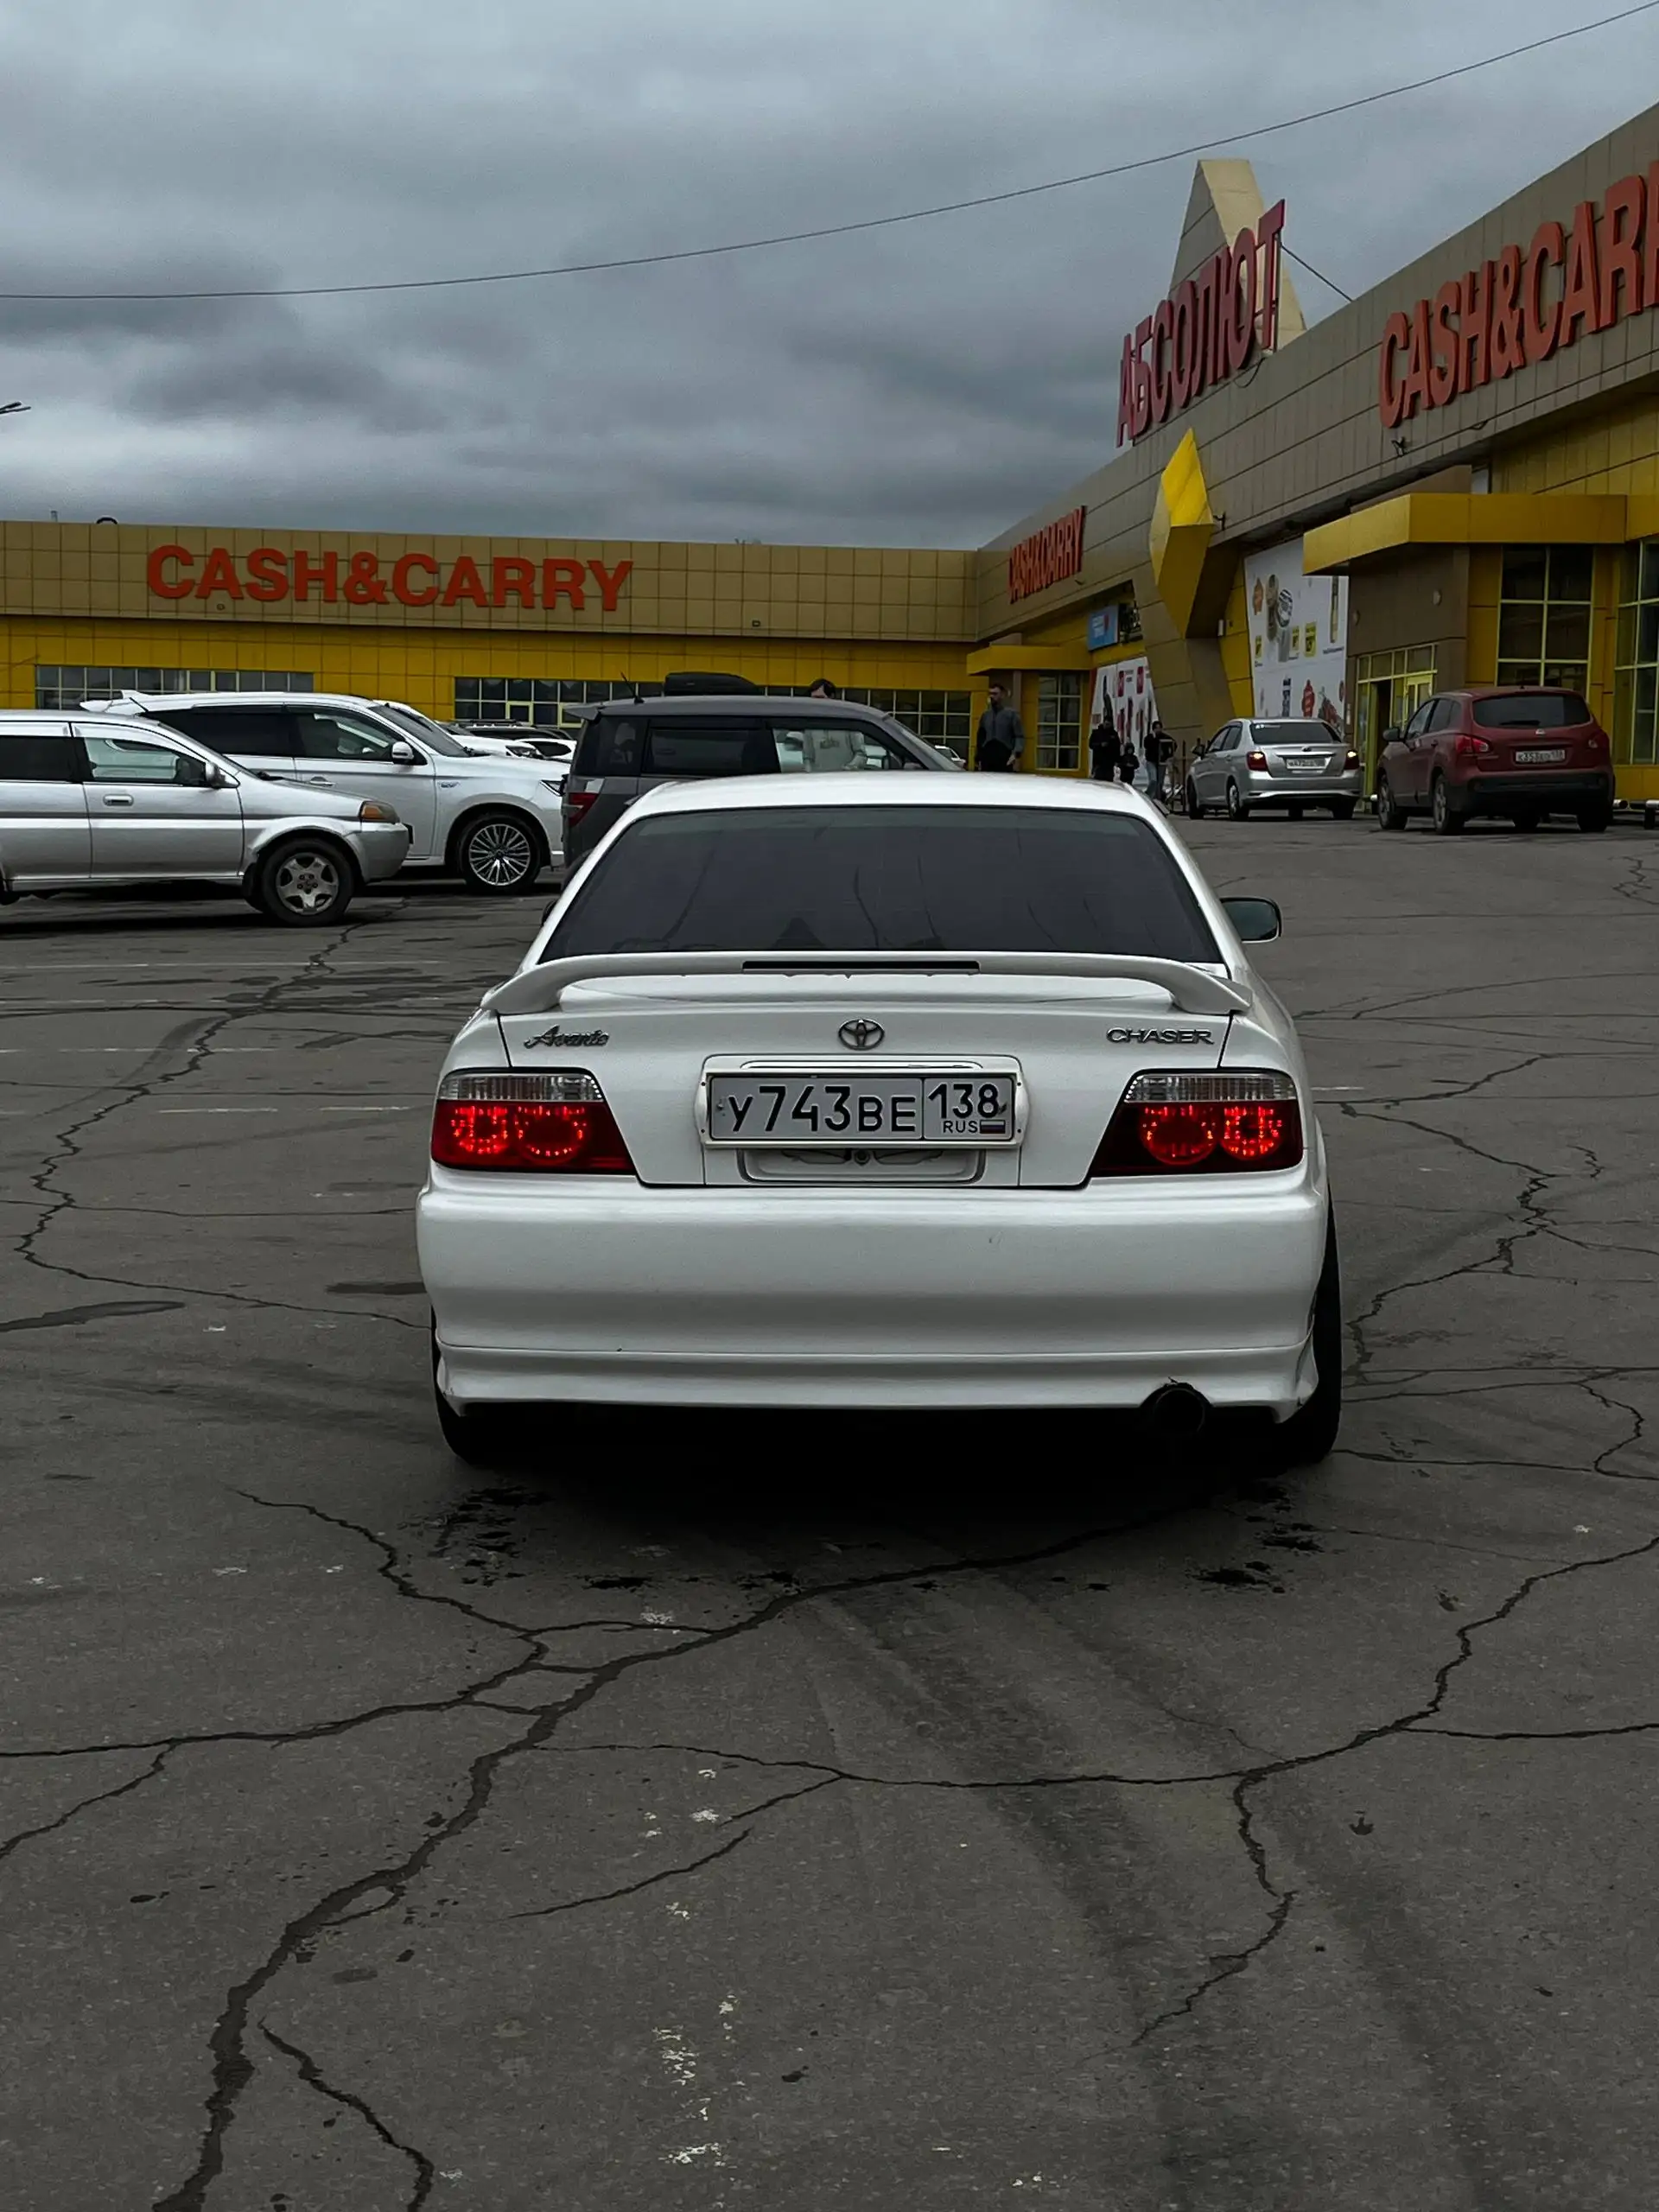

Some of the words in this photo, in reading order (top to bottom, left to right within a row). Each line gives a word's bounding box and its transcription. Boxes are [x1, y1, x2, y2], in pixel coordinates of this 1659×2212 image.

[1116, 199, 1285, 448] АБСОЛЮТ
[147, 545, 633, 612] CASH&CARRY
[1106, 1027, 1214, 1045] CHASER
[728, 1085, 917, 1132] У743ВЕ
[927, 1083, 1000, 1119] 138
[943, 1121, 979, 1134] RUS
